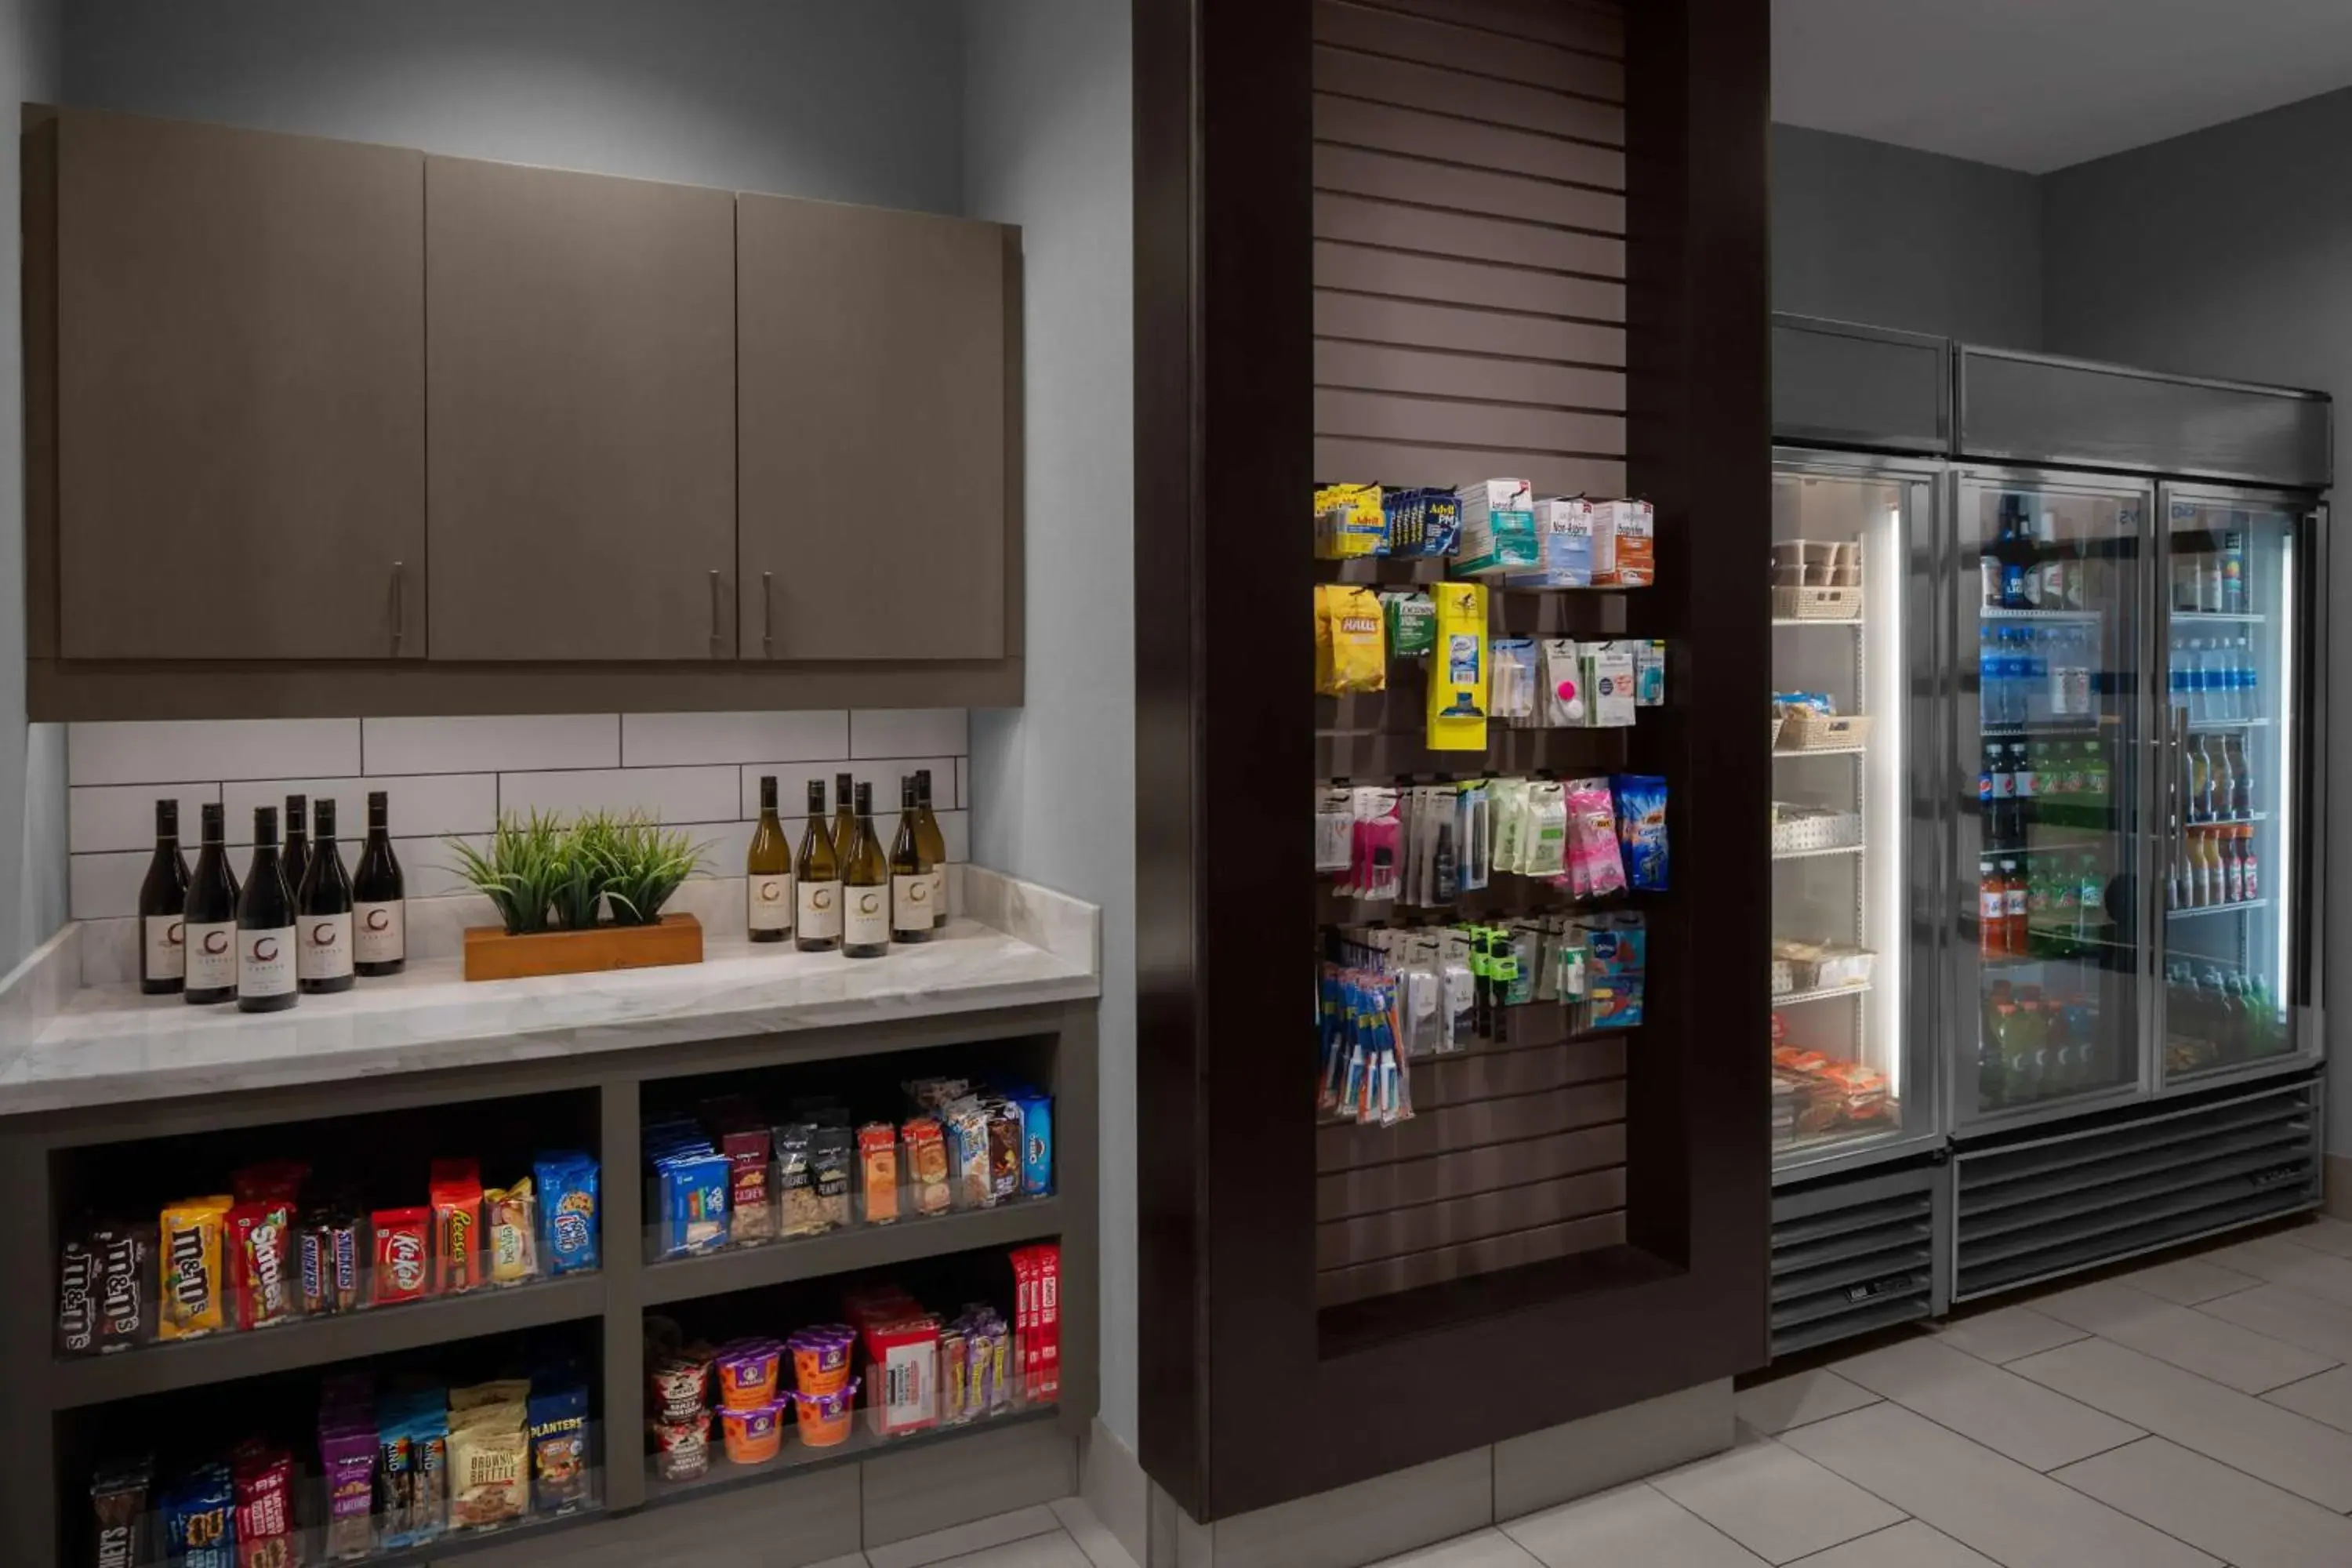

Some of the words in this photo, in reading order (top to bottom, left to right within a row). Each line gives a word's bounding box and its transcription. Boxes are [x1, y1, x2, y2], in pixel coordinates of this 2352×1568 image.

[1429, 503, 1455, 515] Advil
[1438, 514, 1455, 524] PM
[1343, 617, 1375, 631] HALLS
[338, 1232, 353, 1287] SNICKERS
[531, 1417, 583, 1439] PLANTERS
